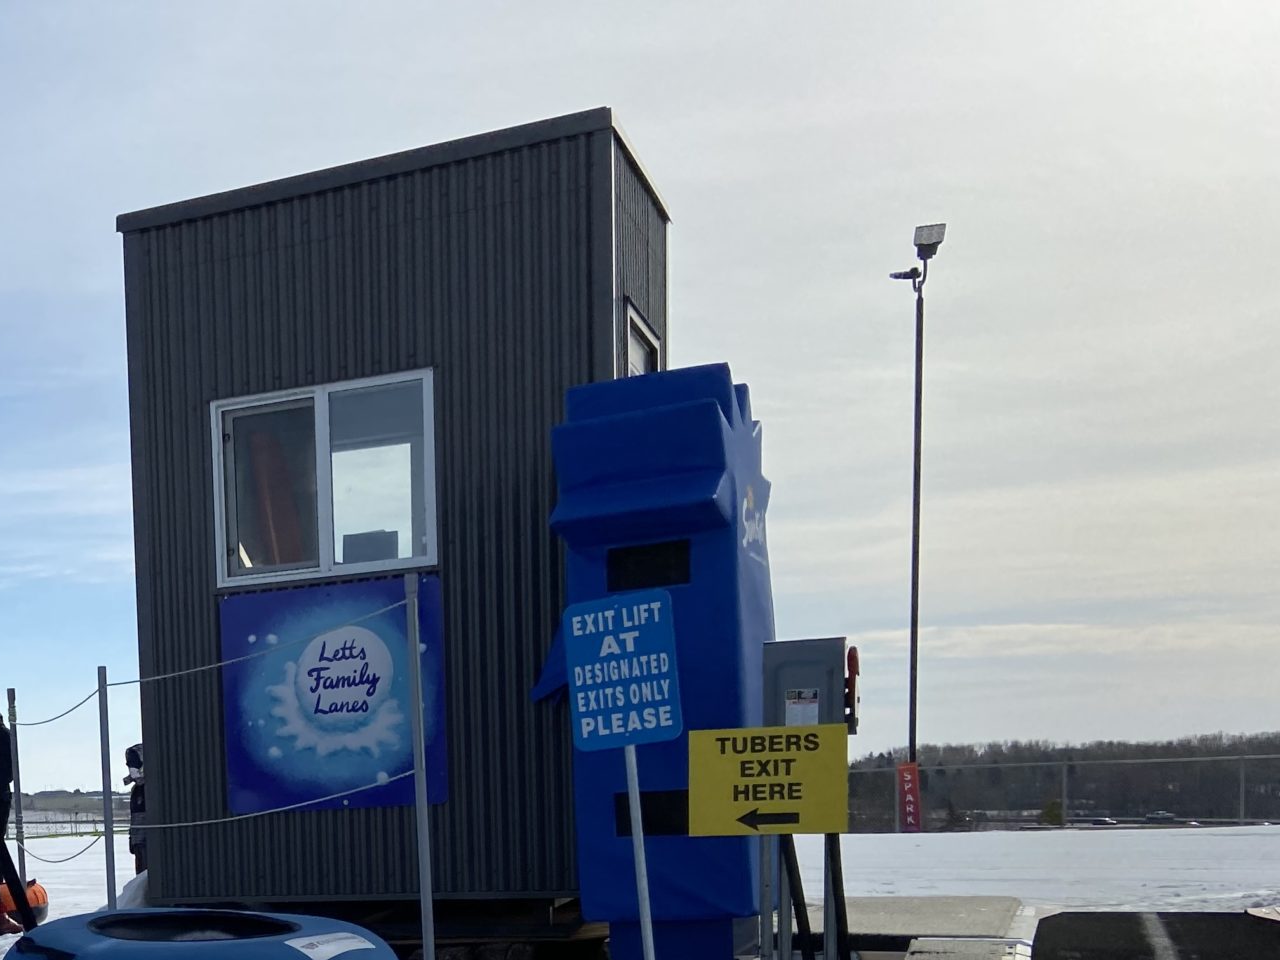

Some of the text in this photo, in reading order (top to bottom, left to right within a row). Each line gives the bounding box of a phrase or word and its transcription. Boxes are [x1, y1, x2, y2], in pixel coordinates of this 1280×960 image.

[572, 601, 662, 636] EXIT LIFT
[318, 638, 367, 663] Letts
[599, 631, 640, 657] AT
[307, 662, 381, 697] Family
[574, 652, 669, 687] DESIGNATED
[313, 694, 369, 715] Lanes
[577, 678, 670, 713] EXITS ONLY
[581, 705, 673, 738] PLEASE
[715, 732, 820, 755] TUBERS
[740, 758, 797, 778] EXIT
[733, 782, 803, 802] HERE
[903, 771, 915, 825] SPARK
